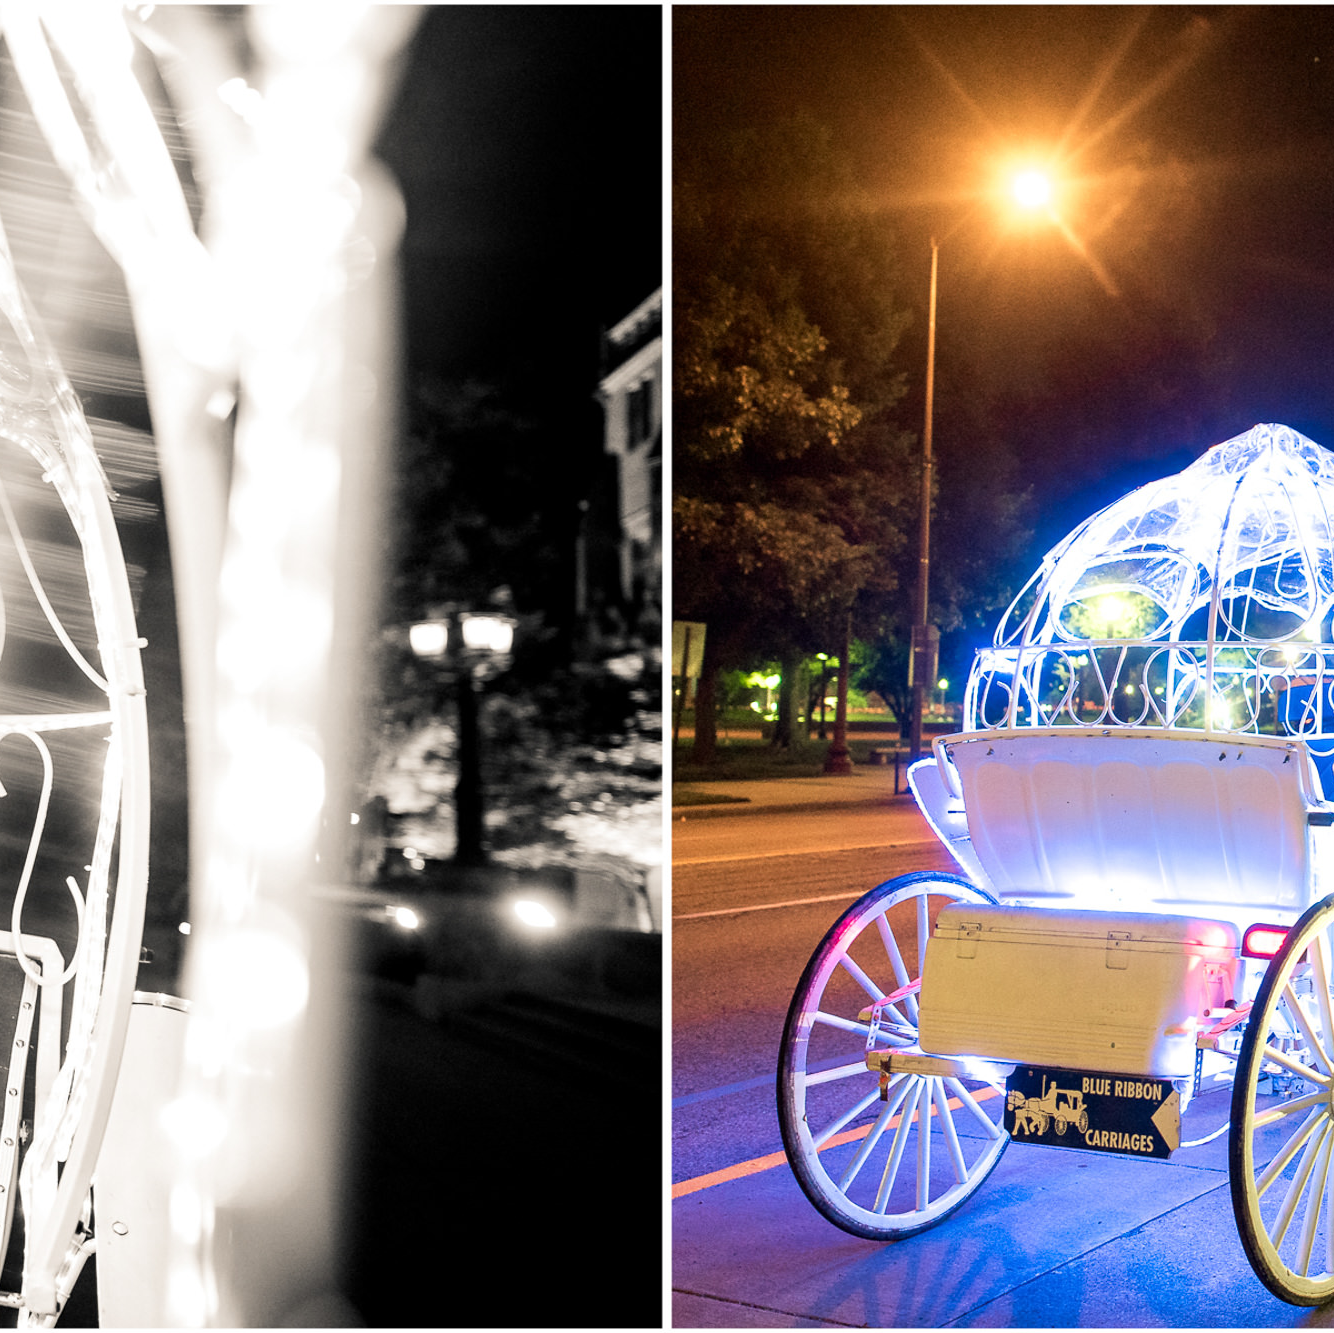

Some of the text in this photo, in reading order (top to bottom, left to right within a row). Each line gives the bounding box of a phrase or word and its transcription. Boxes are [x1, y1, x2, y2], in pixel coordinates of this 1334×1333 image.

[1082, 1077, 1162, 1100] BLUE RIBBON
[1085, 1129, 1154, 1152] CARRIAGES
